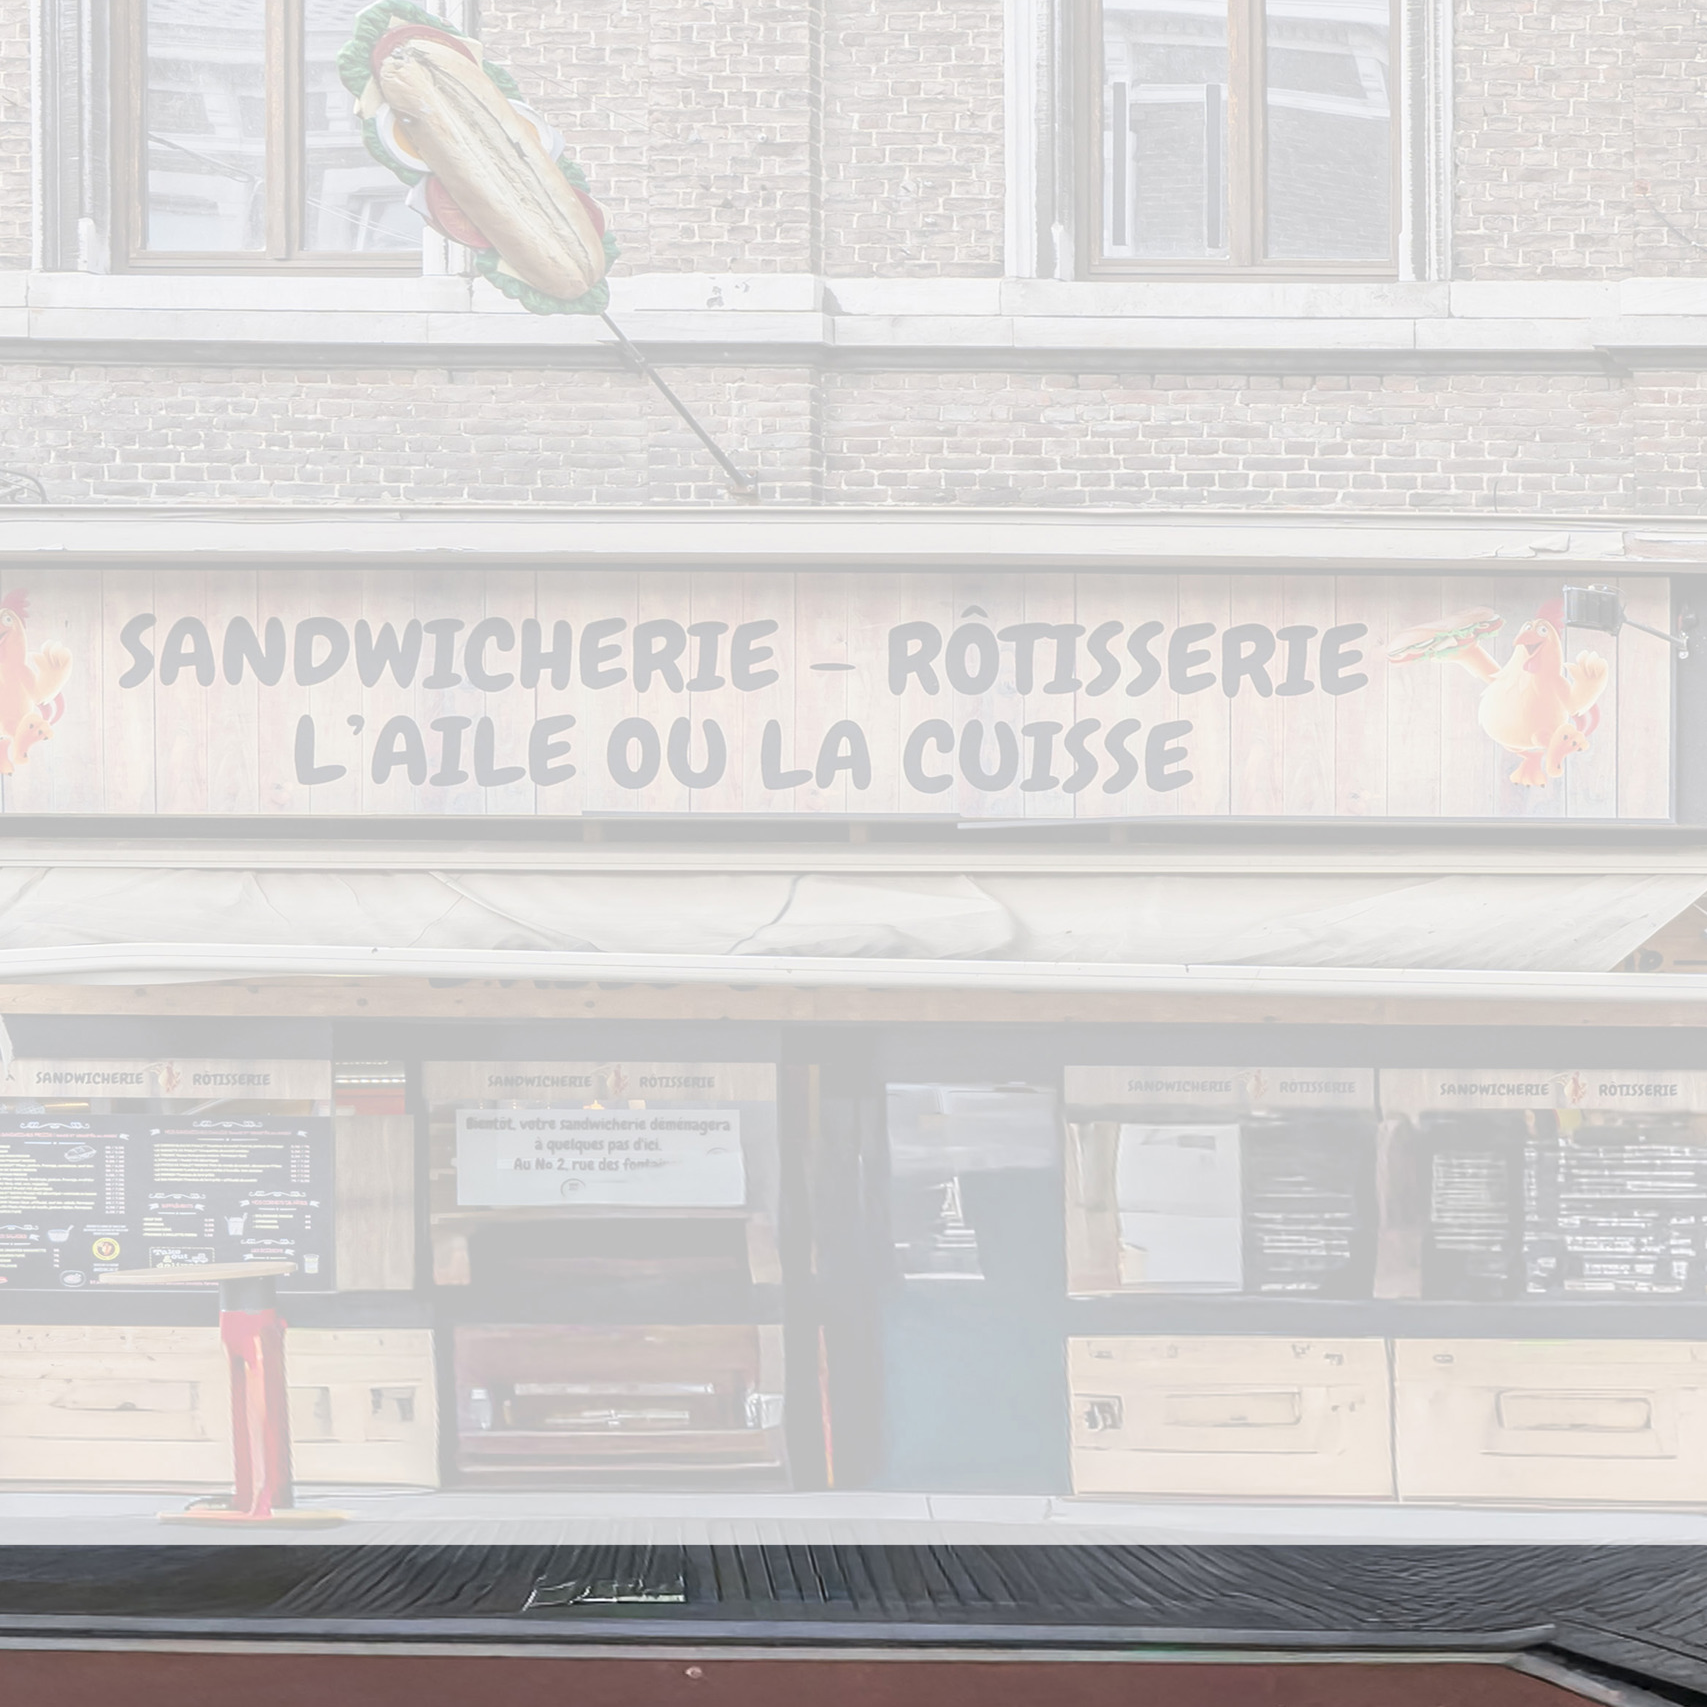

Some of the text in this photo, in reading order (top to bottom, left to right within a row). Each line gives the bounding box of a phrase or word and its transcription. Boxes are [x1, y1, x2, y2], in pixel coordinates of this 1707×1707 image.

[117, 612, 780, 692] SANDWICHERIE
[887, 603, 1370, 698] RÔTISSERIE
[293, 713, 1194, 796] L'AILE OU LA CUISSE
[36, 1071, 144, 1085] SANDWICHERIE
[487, 1074, 593, 1088] SANDWICHERIE
[1127, 1078, 1233, 1094] SANDWICHERIE
[1439, 1082, 1550, 1096] SANDWICHERIE
[519, 1117, 557, 1131] votre
[559, 1116, 647, 1132] sandwicherie
[649, 1116, 731, 1135] déménagera
[534, 1138, 544, 1152] à
[546, 1138, 605, 1156] quelques
[607, 1140, 630, 1155] pas
[513, 1158, 532, 1171] Au
[534, 1158, 553, 1171] No
[571, 1159, 596, 1171] rue
[597, 1157, 621, 1171] des
